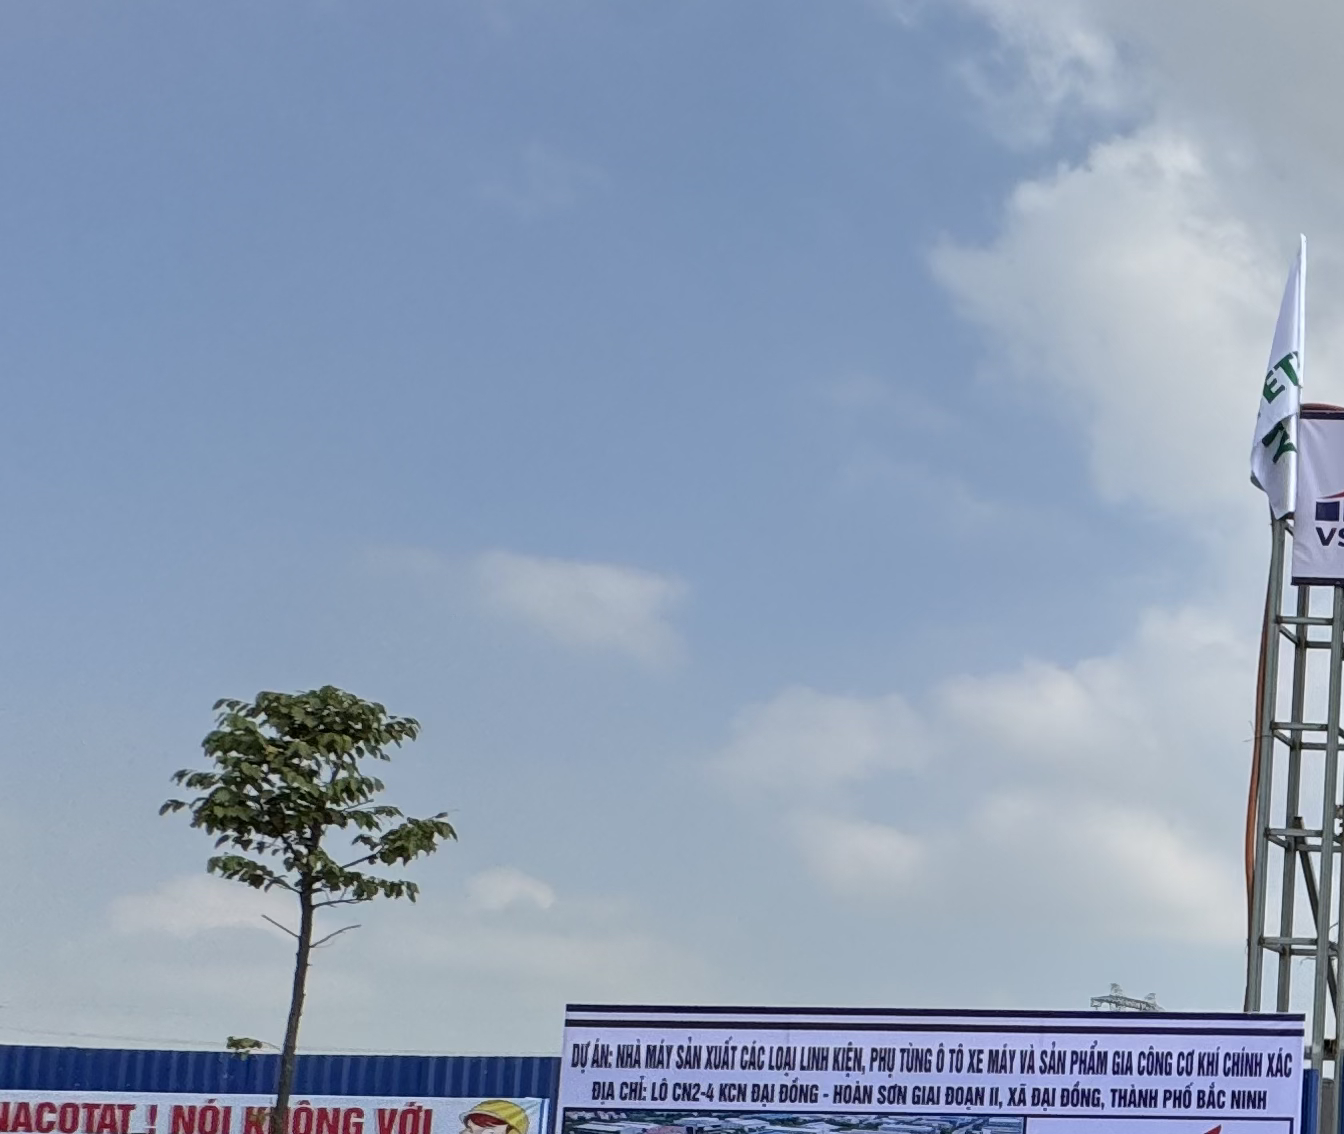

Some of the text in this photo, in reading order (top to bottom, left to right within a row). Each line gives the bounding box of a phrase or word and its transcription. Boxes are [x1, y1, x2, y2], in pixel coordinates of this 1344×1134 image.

[571, 1035, 1293, 1078] DỰ ÁN: NHÀ MÁY SẢN XUẤT CÁC LOẠI LINH KIỆN, PHỤ TÙNG Ô TÔ XE MÁY VÀ SẢN PHẨM GIA CÔNG CƠ KHÍ CHÍNH XÁC
[592, 1082, 614, 1106] ĐỊA
[619, 1076, 646, 1101] CHỈ:
[651, 1078, 668, 1101] LÔ
[672, 1083, 714, 1102] CN2-4
[718, 1083, 747, 1102] KCN
[751, 1084, 775, 1108] ĐẠI
[778, 1077, 819, 1103] ĐỒNG
[833, 1081, 873, 1104] HOÀN
[877, 1083, 907, 1105] SƠN
[912, 1086, 941, 1105] GIAI
[945, 1086, 985, 1111] ĐOẠN
[989, 1087, 1002, 1109] II,
[1007, 1083, 1026, 1106] XÃ
[1031, 1087, 1056, 1112] ĐẠI
[1060, 1081, 1105, 1110] ĐỒNG,
[1110, 1084, 1158, 1108] THÀNH
[1162, 1082, 1193, 1108] PHỐ
[1197, 1082, 1226, 1109] BẮC
[1230, 1090, 1267, 1109] NINH
